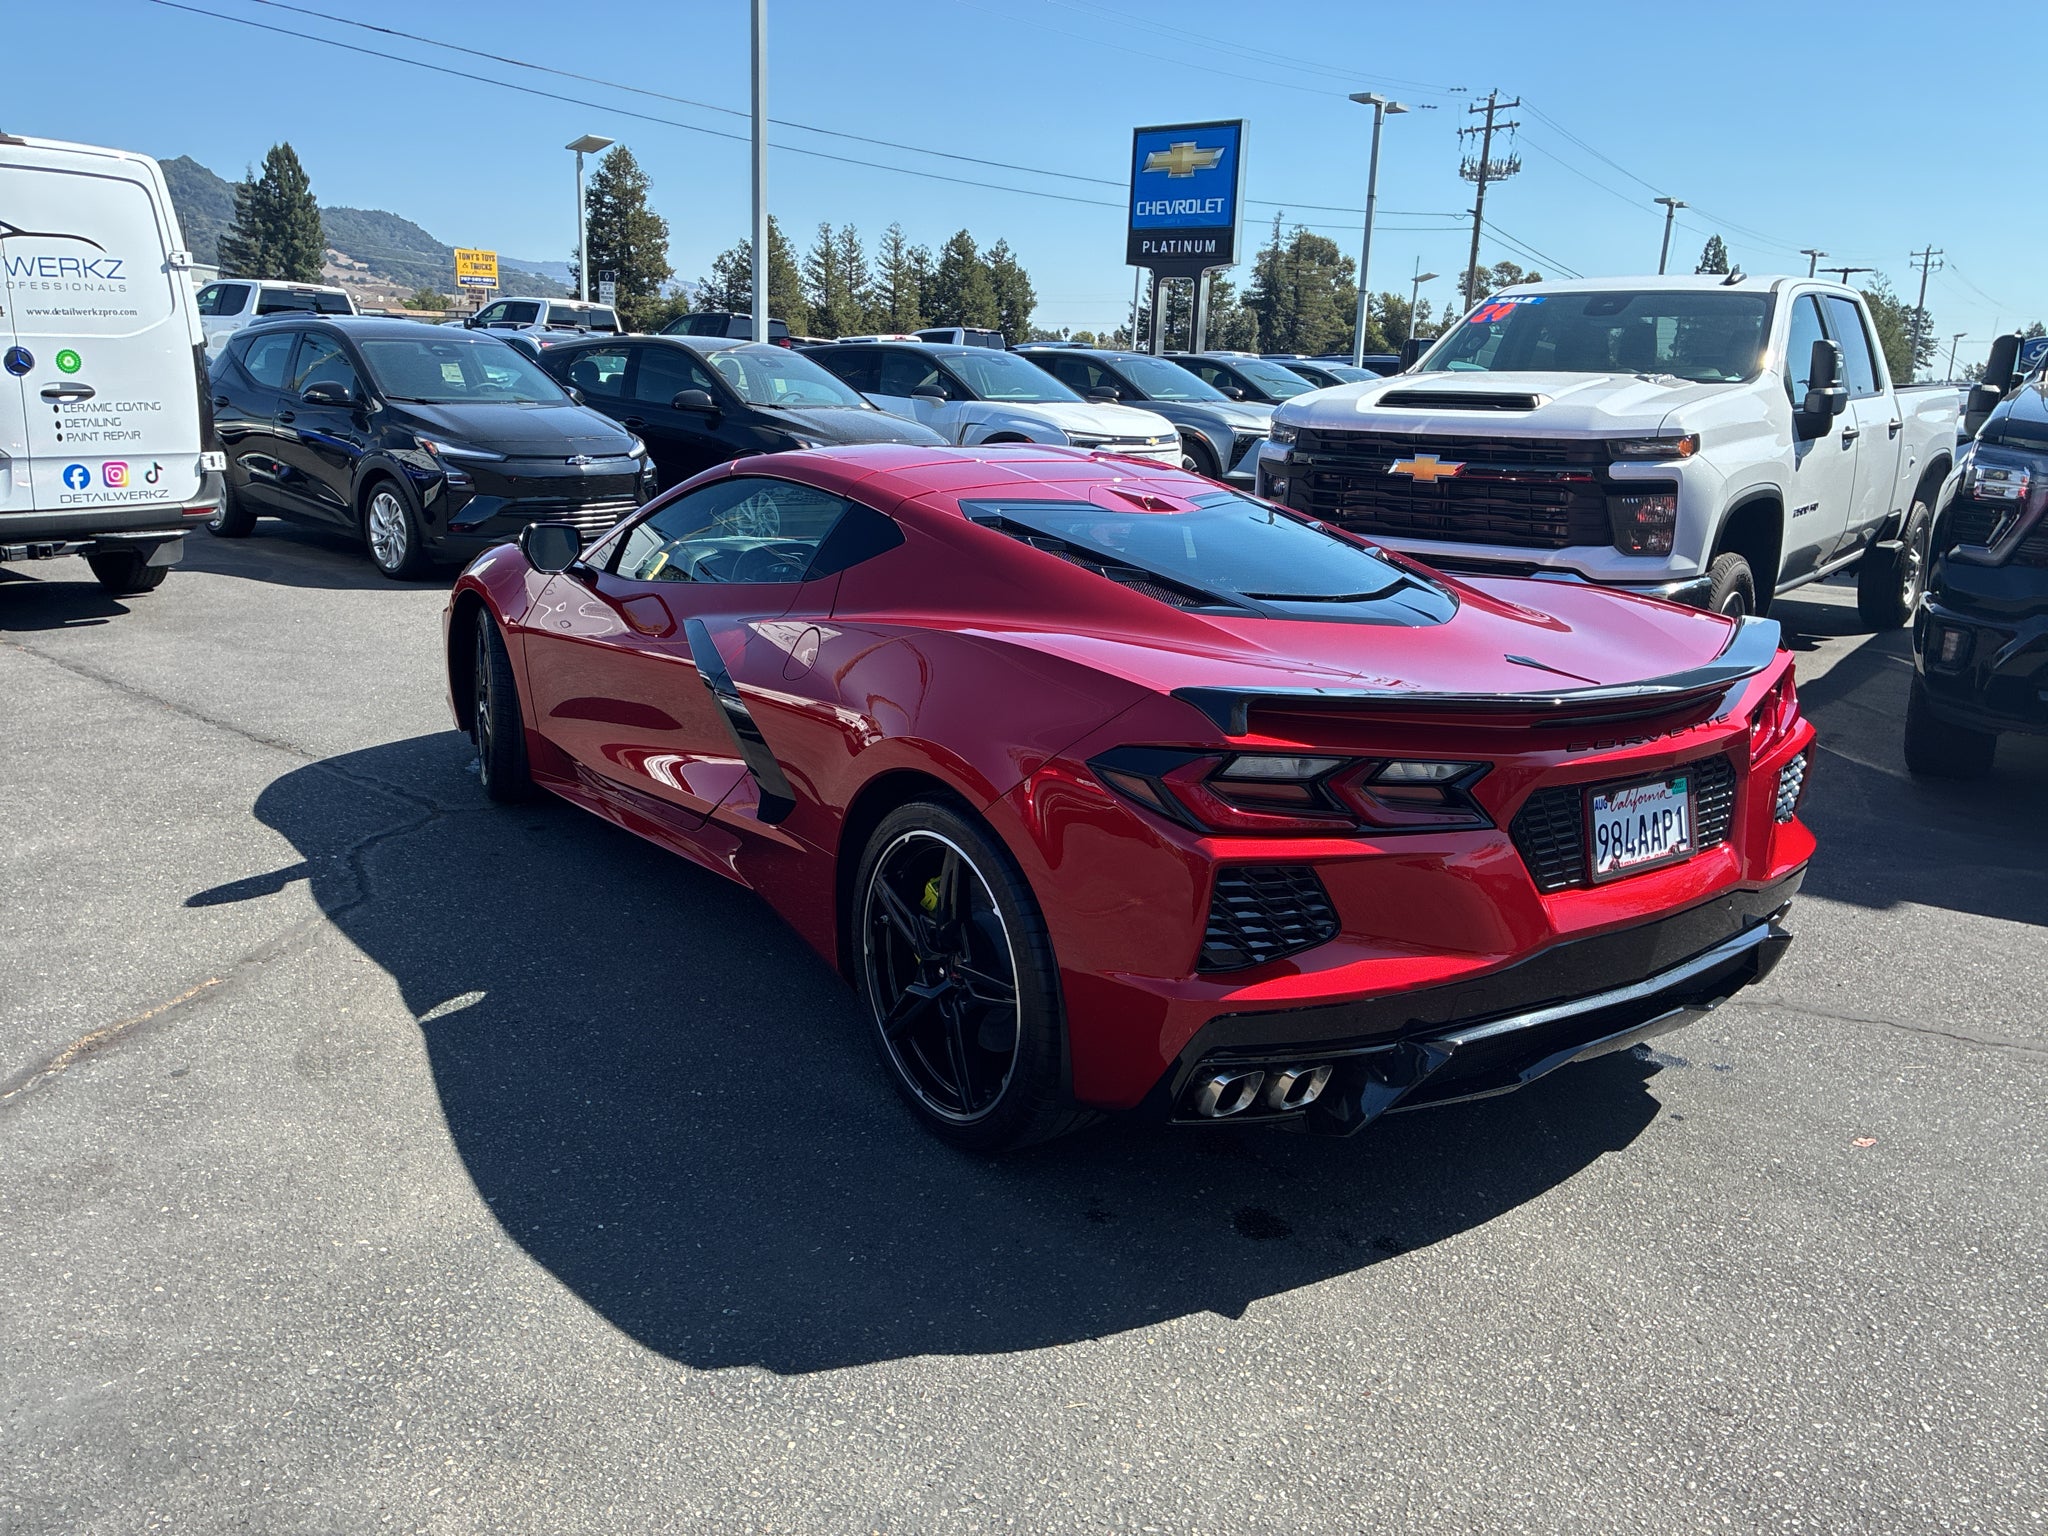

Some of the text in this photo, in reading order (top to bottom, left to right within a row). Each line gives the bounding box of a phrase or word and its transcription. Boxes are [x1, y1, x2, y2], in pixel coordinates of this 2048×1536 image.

[1136, 198, 1225, 216] CHEVROLET
[1142, 239, 1216, 253] PLATINUM
[458, 252, 496, 262] TONY'S TOYS
[4, 256, 126, 280] WERKZ
[470, 262, 493, 271] TRUCKS
[1496, 296, 1537, 304] SALE
[26, 307, 138, 318] www.detailwerkzpro.com
[63, 402, 161, 413] CERAMIC COATING
[65, 418, 122, 428] DETAILING
[66, 431, 141, 442] PAINT REPAIR
[60, 489, 170, 504] DETAILWERKZ
[1566, 713, 1730, 752] CORVETTE
[1594, 785, 1673, 813] AUG California
[1597, 805, 1688, 866] 984AAP1
